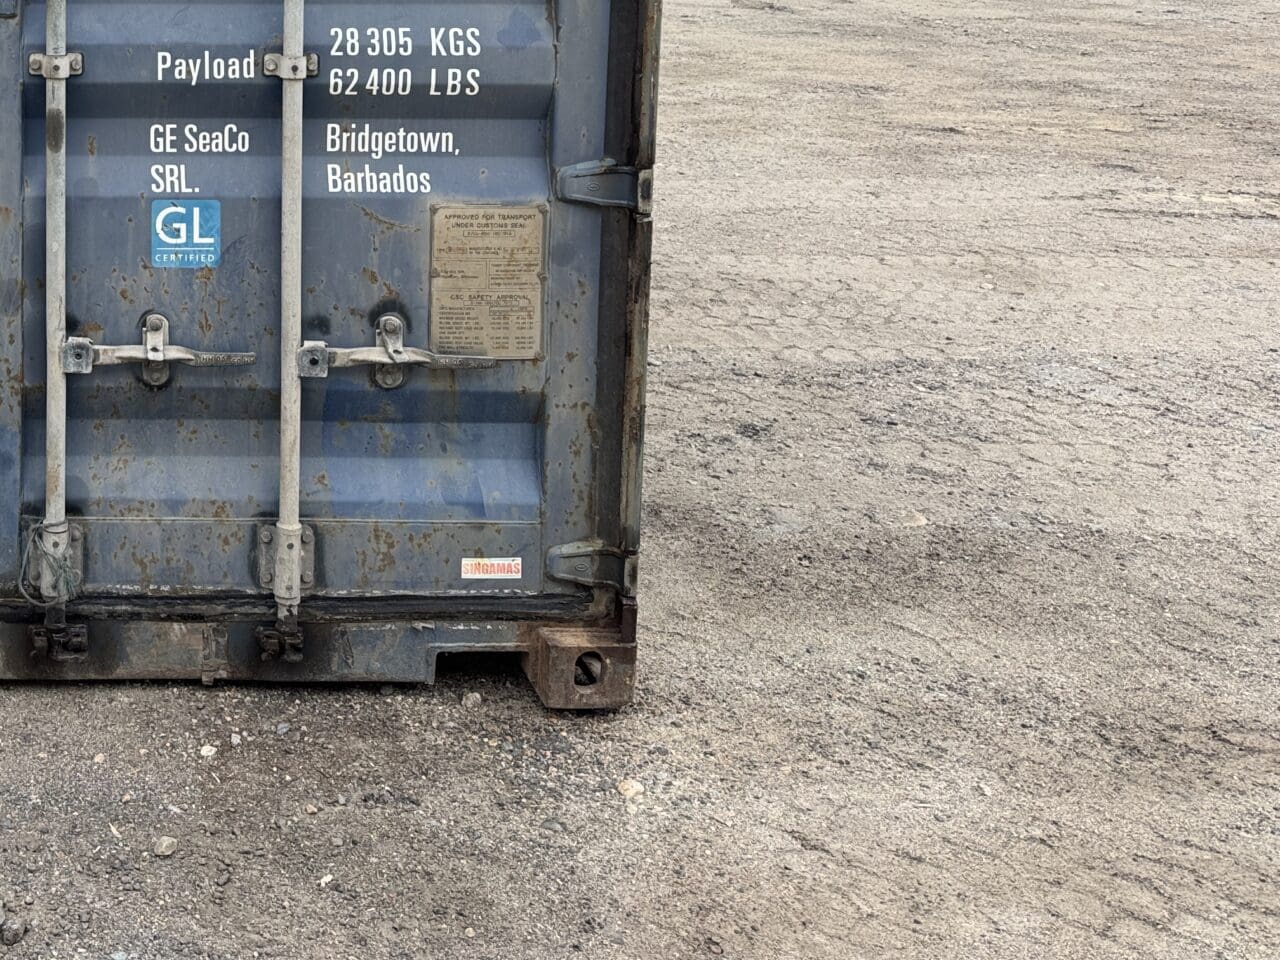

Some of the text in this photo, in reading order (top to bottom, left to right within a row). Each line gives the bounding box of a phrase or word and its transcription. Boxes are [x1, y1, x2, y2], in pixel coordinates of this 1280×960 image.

[157, 49, 255, 86] Payload
[430, 27, 481, 56] KGS
[429, 68, 480, 95] LBS
[150, 124, 460, 159] GE SeaCo Bridgetown,
[151, 164, 431, 193] SRL. Barbados
[156, 206, 215, 244] GL
[155, 254, 215, 262] CERTIFIED
[462, 562, 520, 575] SINGAMAS
